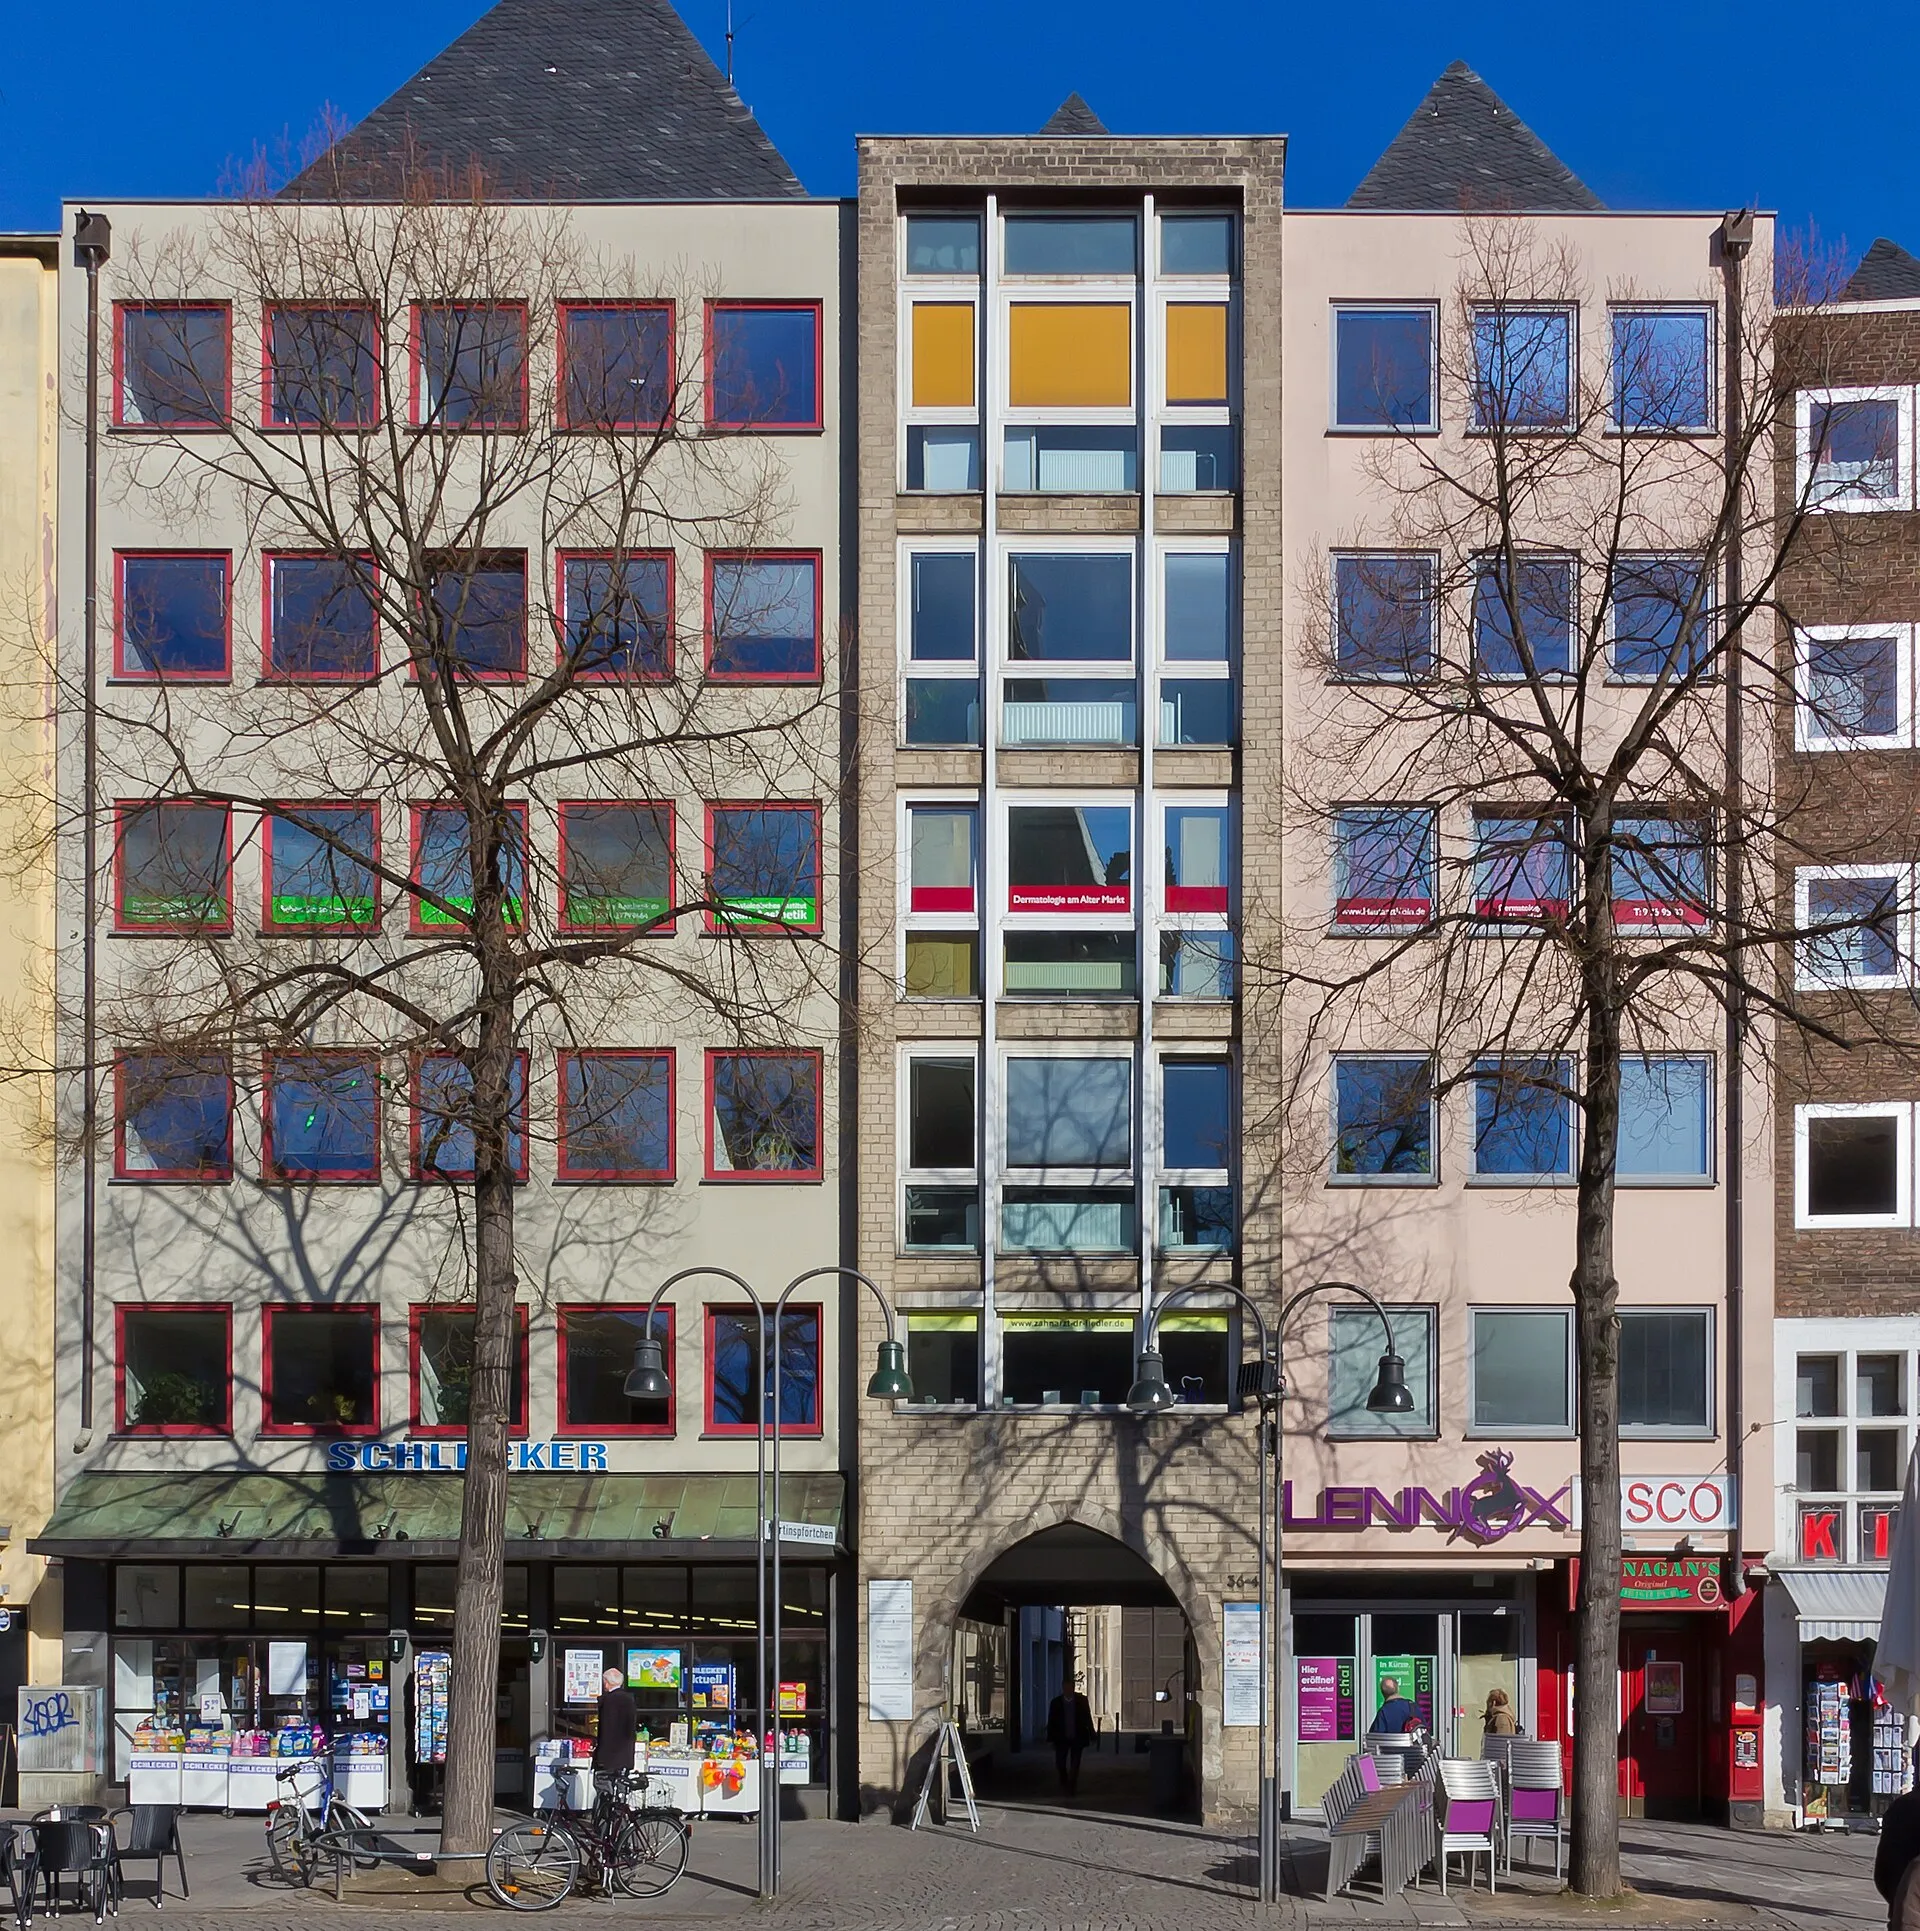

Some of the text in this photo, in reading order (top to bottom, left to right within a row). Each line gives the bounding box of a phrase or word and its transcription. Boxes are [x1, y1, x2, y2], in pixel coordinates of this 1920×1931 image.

[1013, 895, 1125, 906] Dermatologie am Alter Markt
[328, 1441, 609, 1471] SCHLKER
[1626, 1482, 1723, 1524] SCO
[1301, 1665, 1318, 1674] Hier
[1416, 1661, 1428, 1692] chai
[1301, 1676, 1334, 1684] eröffnet
[1338, 1665, 1350, 1696] chai
[132, 1761, 177, 1769] SCHLECKER
